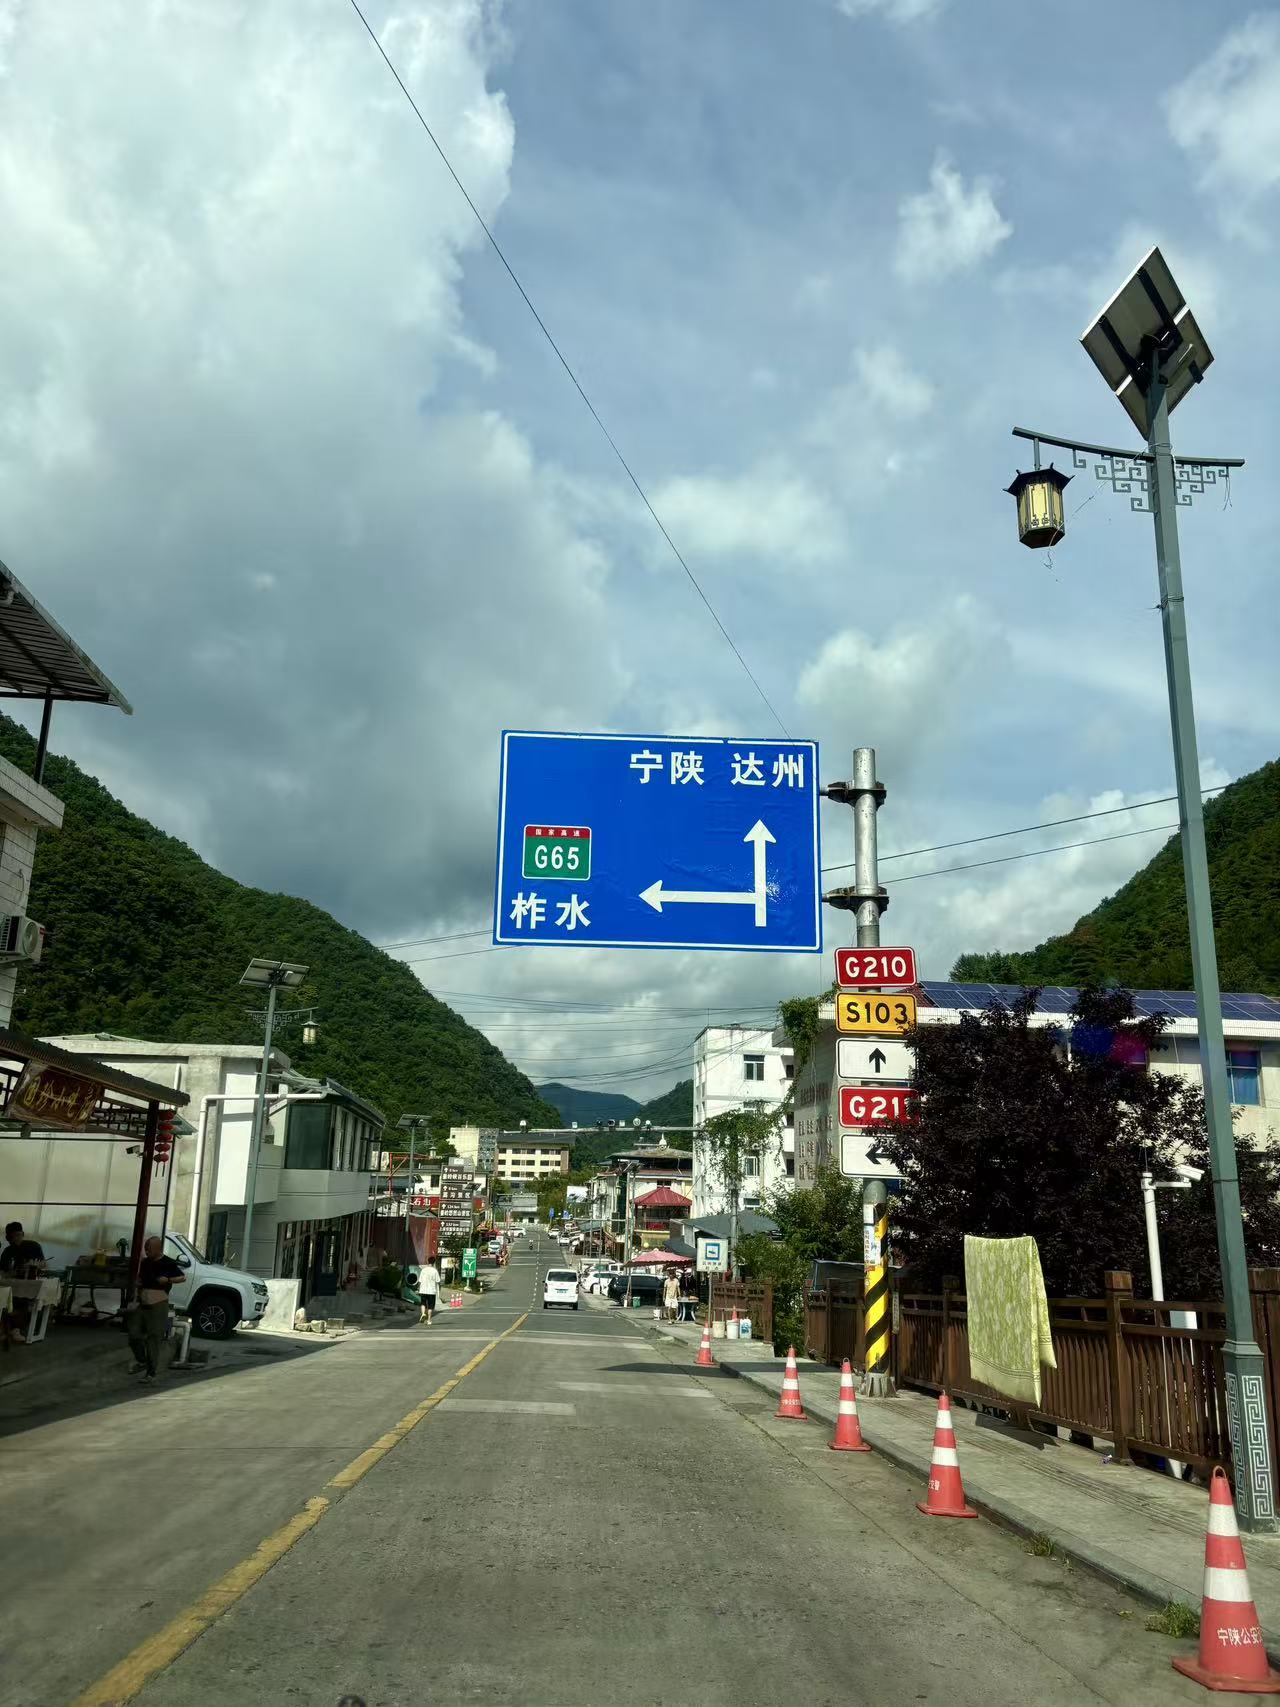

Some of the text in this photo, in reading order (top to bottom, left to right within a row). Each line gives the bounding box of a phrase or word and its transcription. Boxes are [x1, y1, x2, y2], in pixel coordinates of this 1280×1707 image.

[629, 749, 805, 788] 宁陕 达州
[535, 829, 581, 837] 国家高速
[534, 845, 580, 870] G65
[509, 892, 592, 931] 柞水
[845, 956, 907, 978] G210
[846, 1001, 908, 1025] S103
